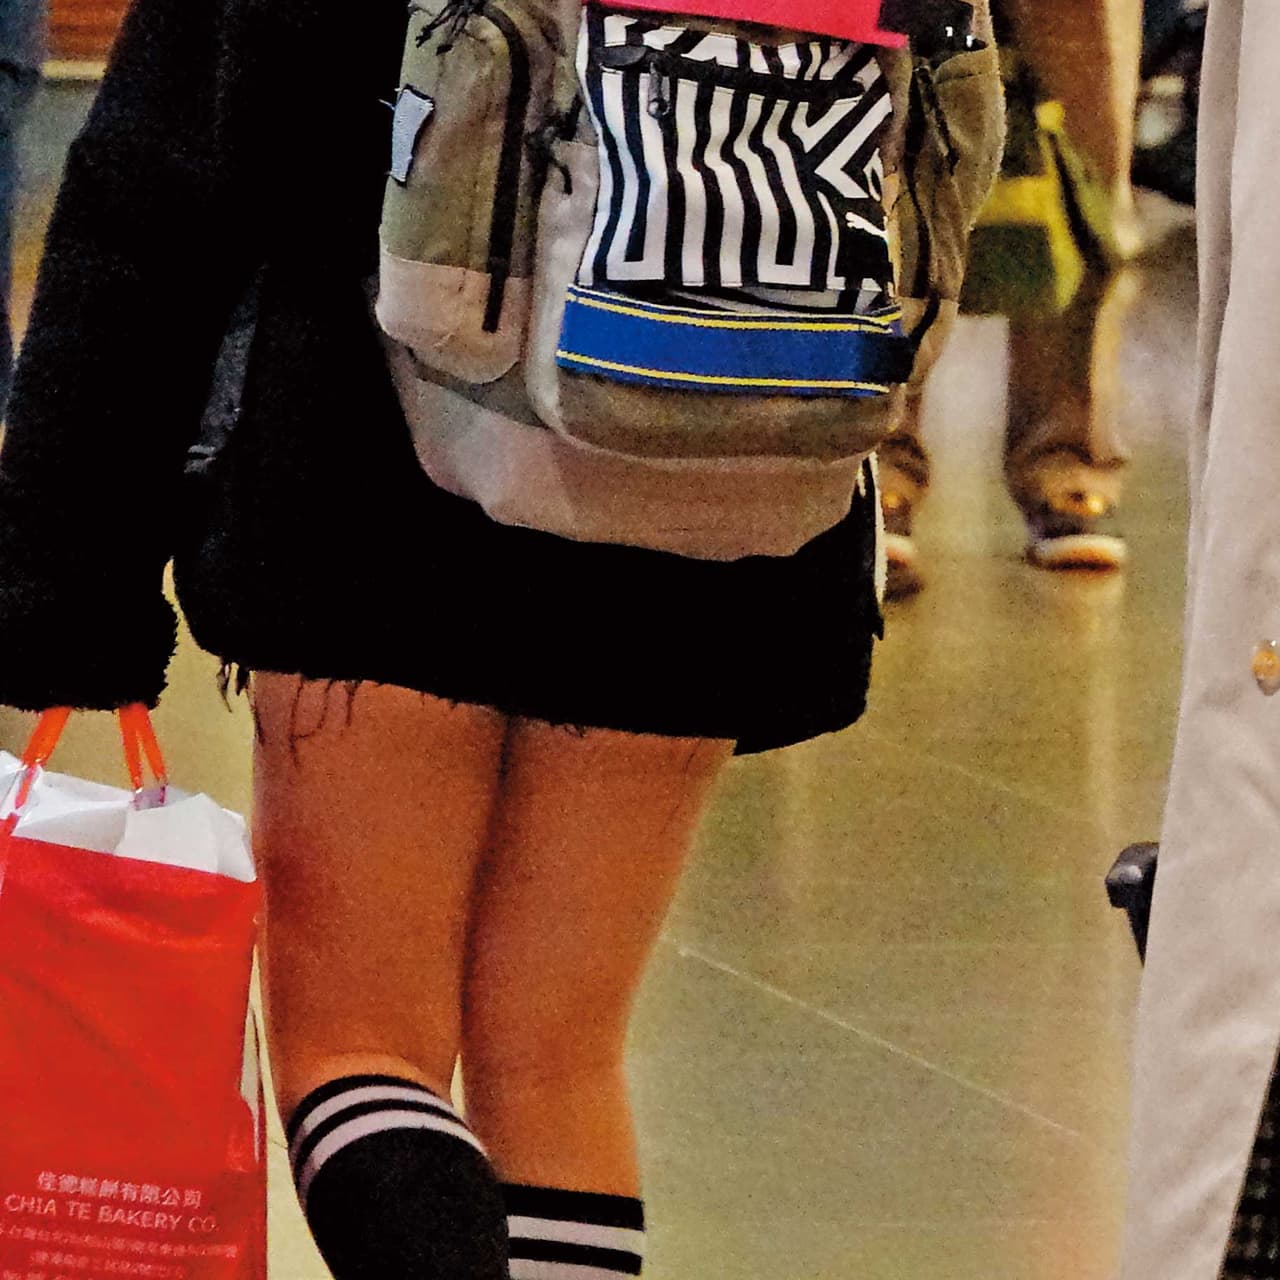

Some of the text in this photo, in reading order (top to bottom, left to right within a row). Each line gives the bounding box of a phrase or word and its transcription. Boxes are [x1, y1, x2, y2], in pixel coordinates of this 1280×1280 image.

[4, 1194, 56, 1217] CHIA
[67, 1200, 91, 1220] TE
[98, 1205, 182, 1231] BAKERY
